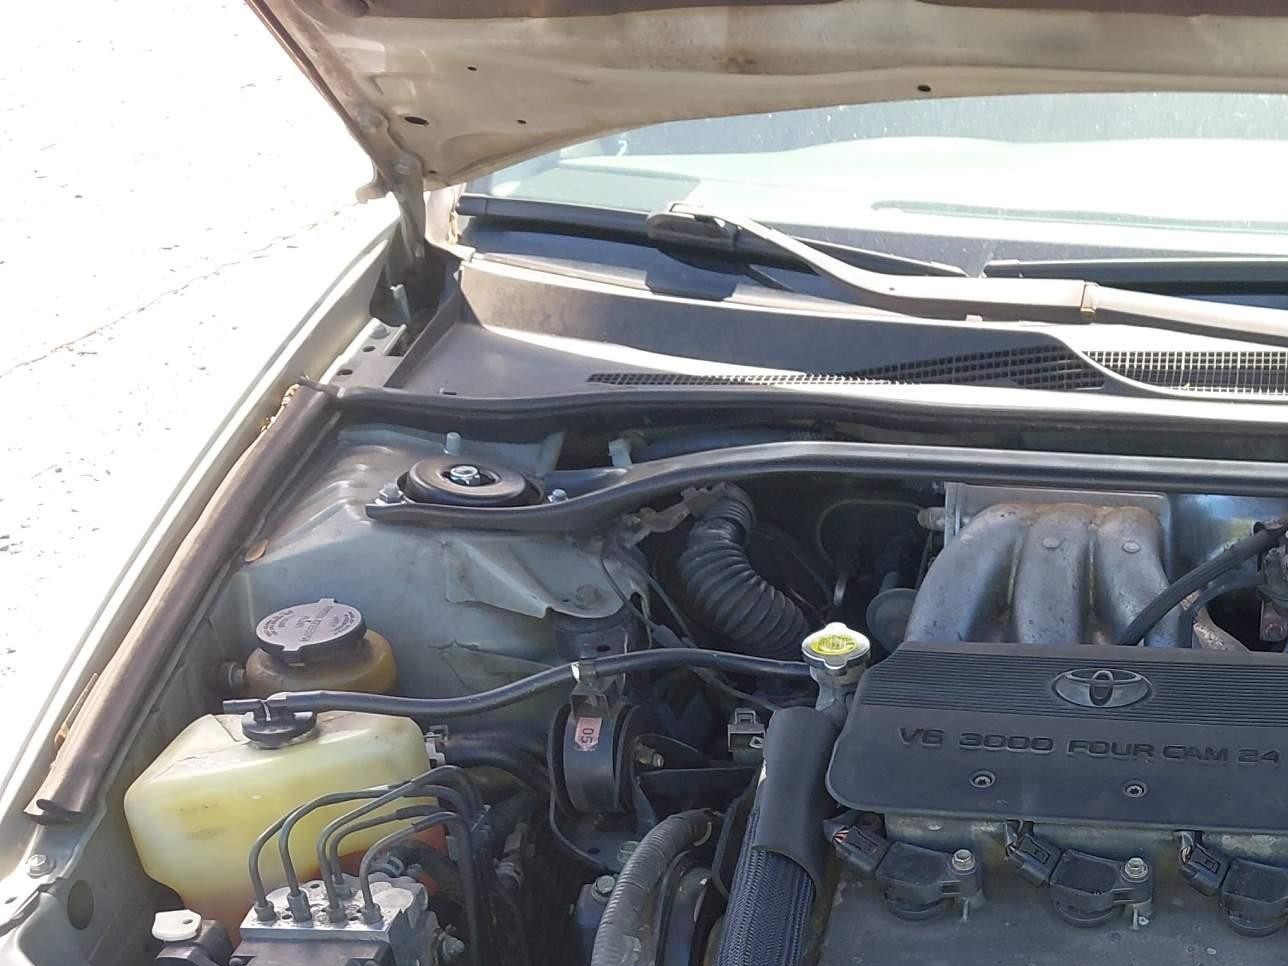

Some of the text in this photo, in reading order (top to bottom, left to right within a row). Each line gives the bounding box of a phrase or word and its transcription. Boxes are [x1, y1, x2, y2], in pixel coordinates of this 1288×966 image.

[899, 727, 1280, 768] V6 3000 FOUR CAM 24
